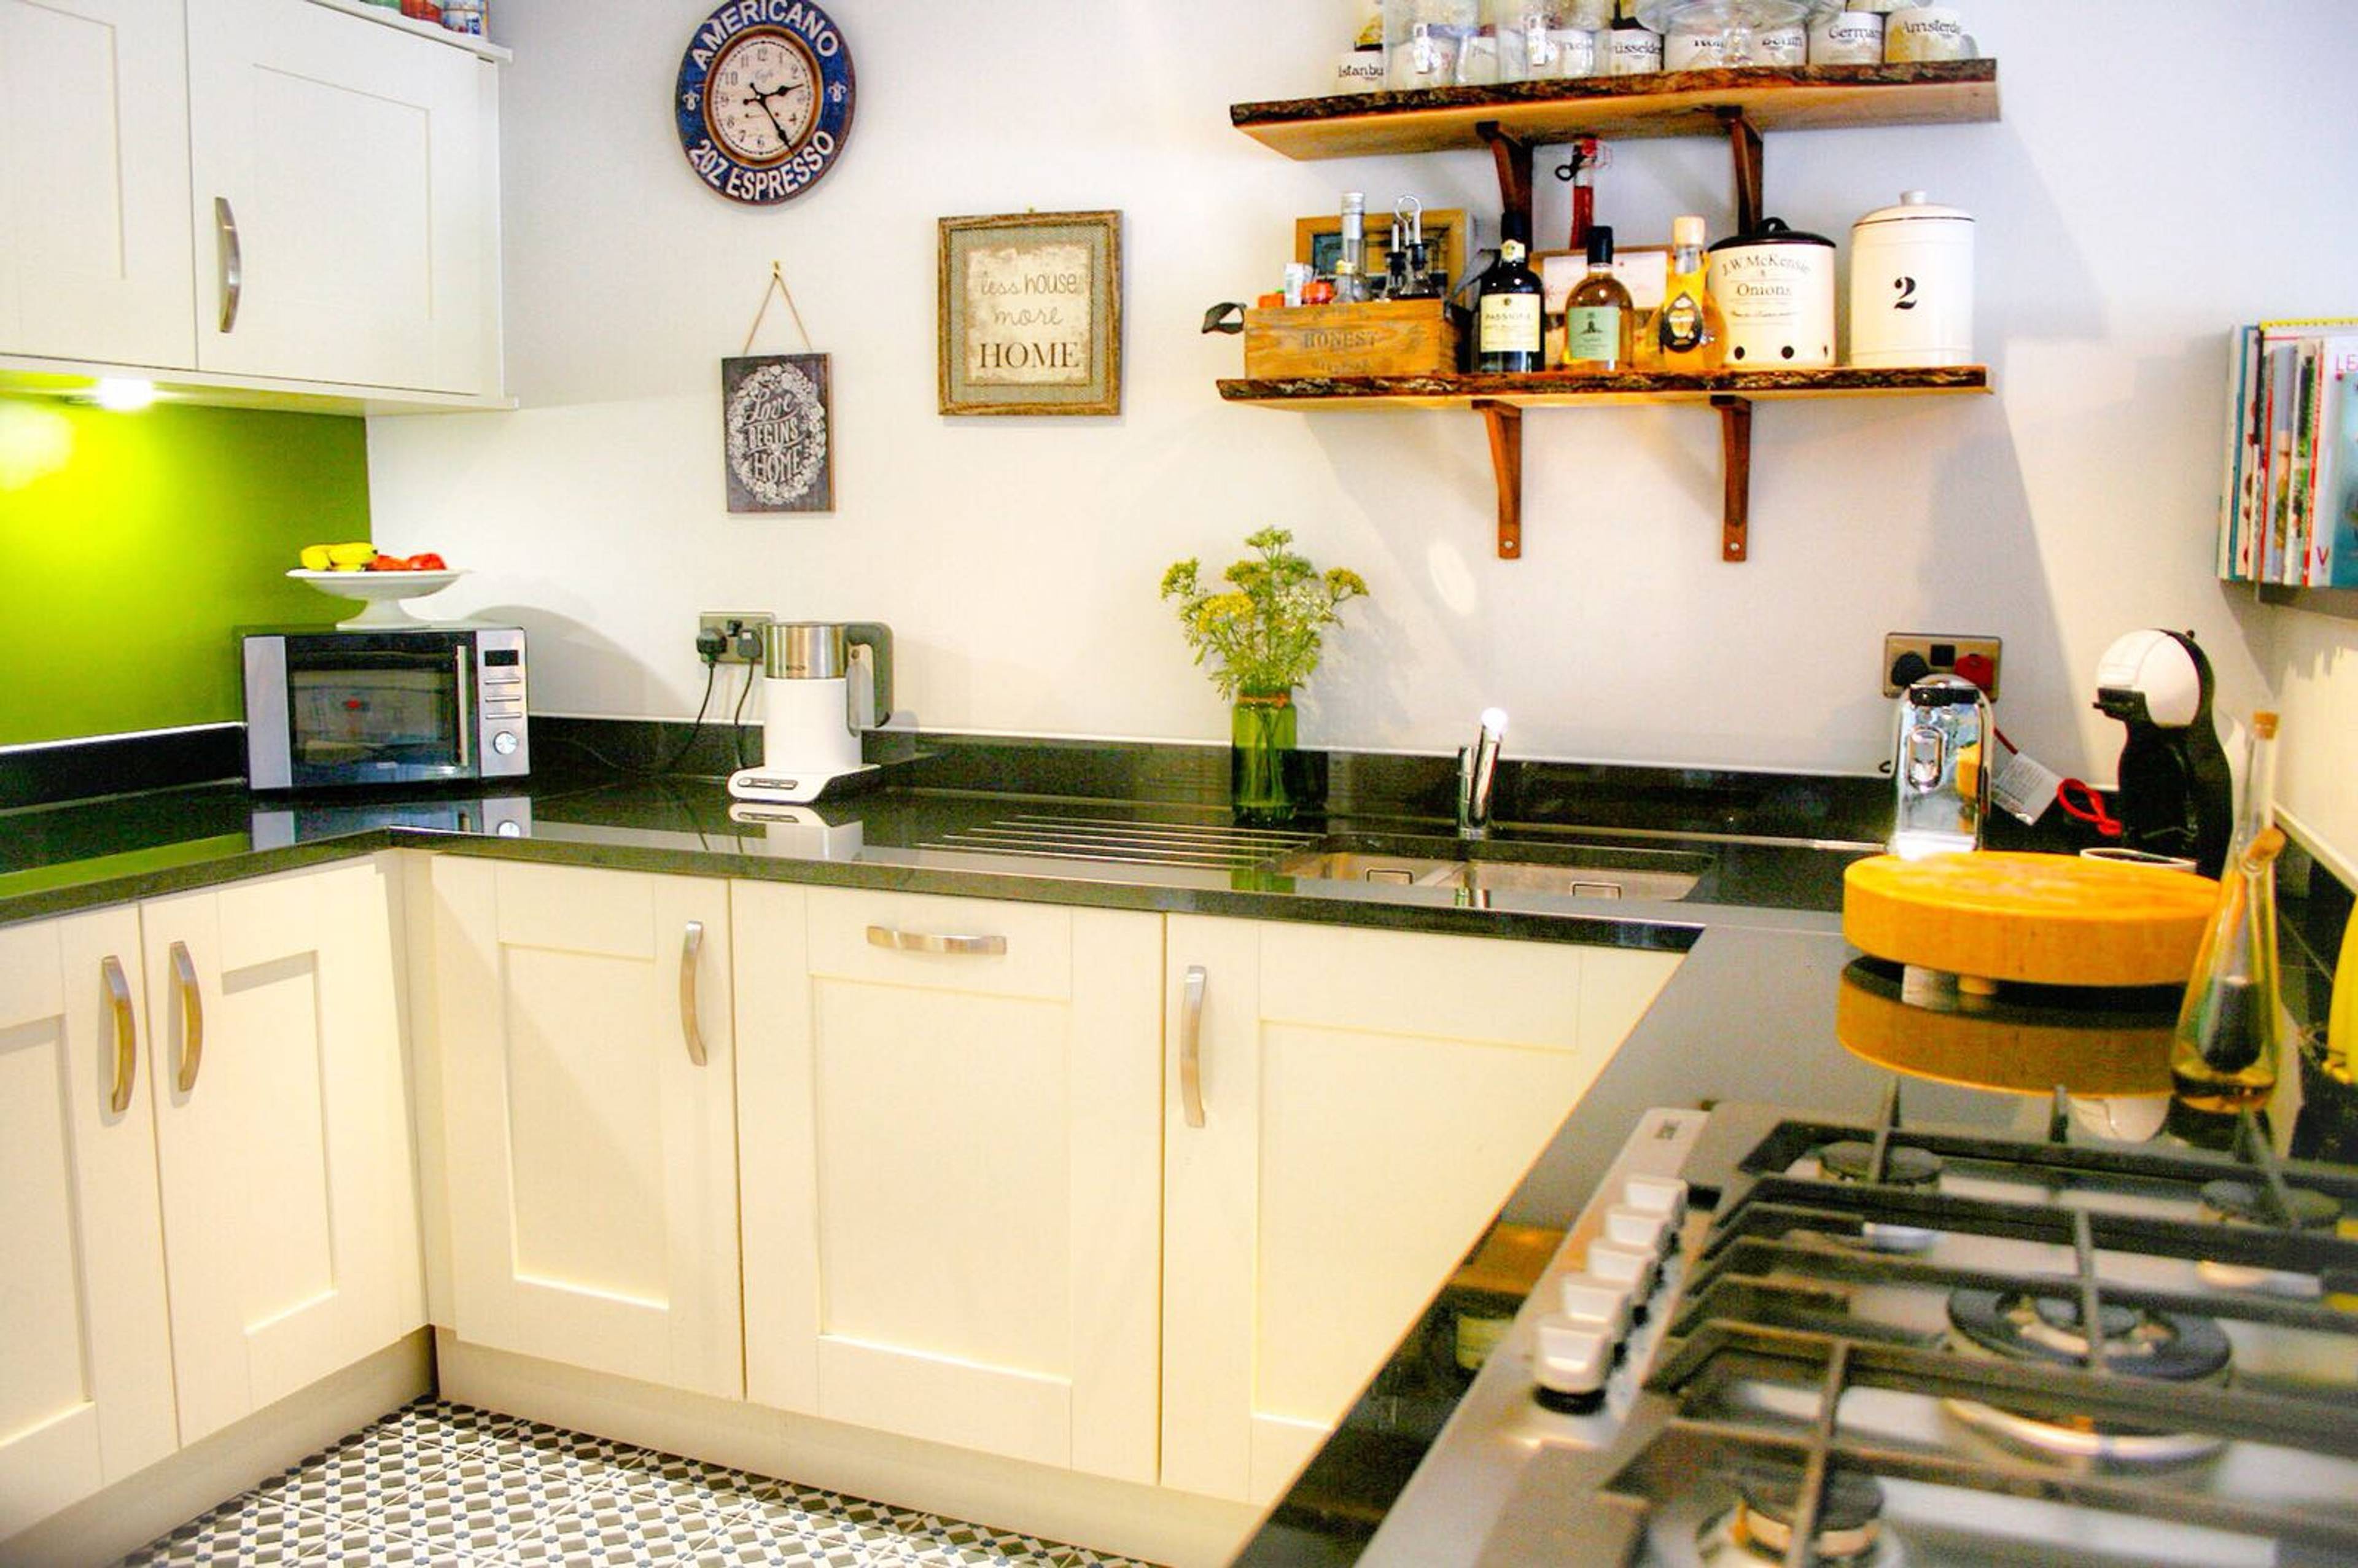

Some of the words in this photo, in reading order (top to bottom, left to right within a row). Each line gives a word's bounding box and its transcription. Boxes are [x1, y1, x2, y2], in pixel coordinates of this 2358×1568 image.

[692, 0, 839, 72] AMERICANO
[725, 130, 835, 201] ESPRESSO
[1024, 273, 1078, 295] house
[1893, 276, 1917, 310] 2
[992, 306, 1064, 326] more
[979, 341, 1080, 368] HOME
[744, 388, 793, 422] Love
[748, 417, 799, 449] BEGINS
[753, 445, 803, 483] HOME
